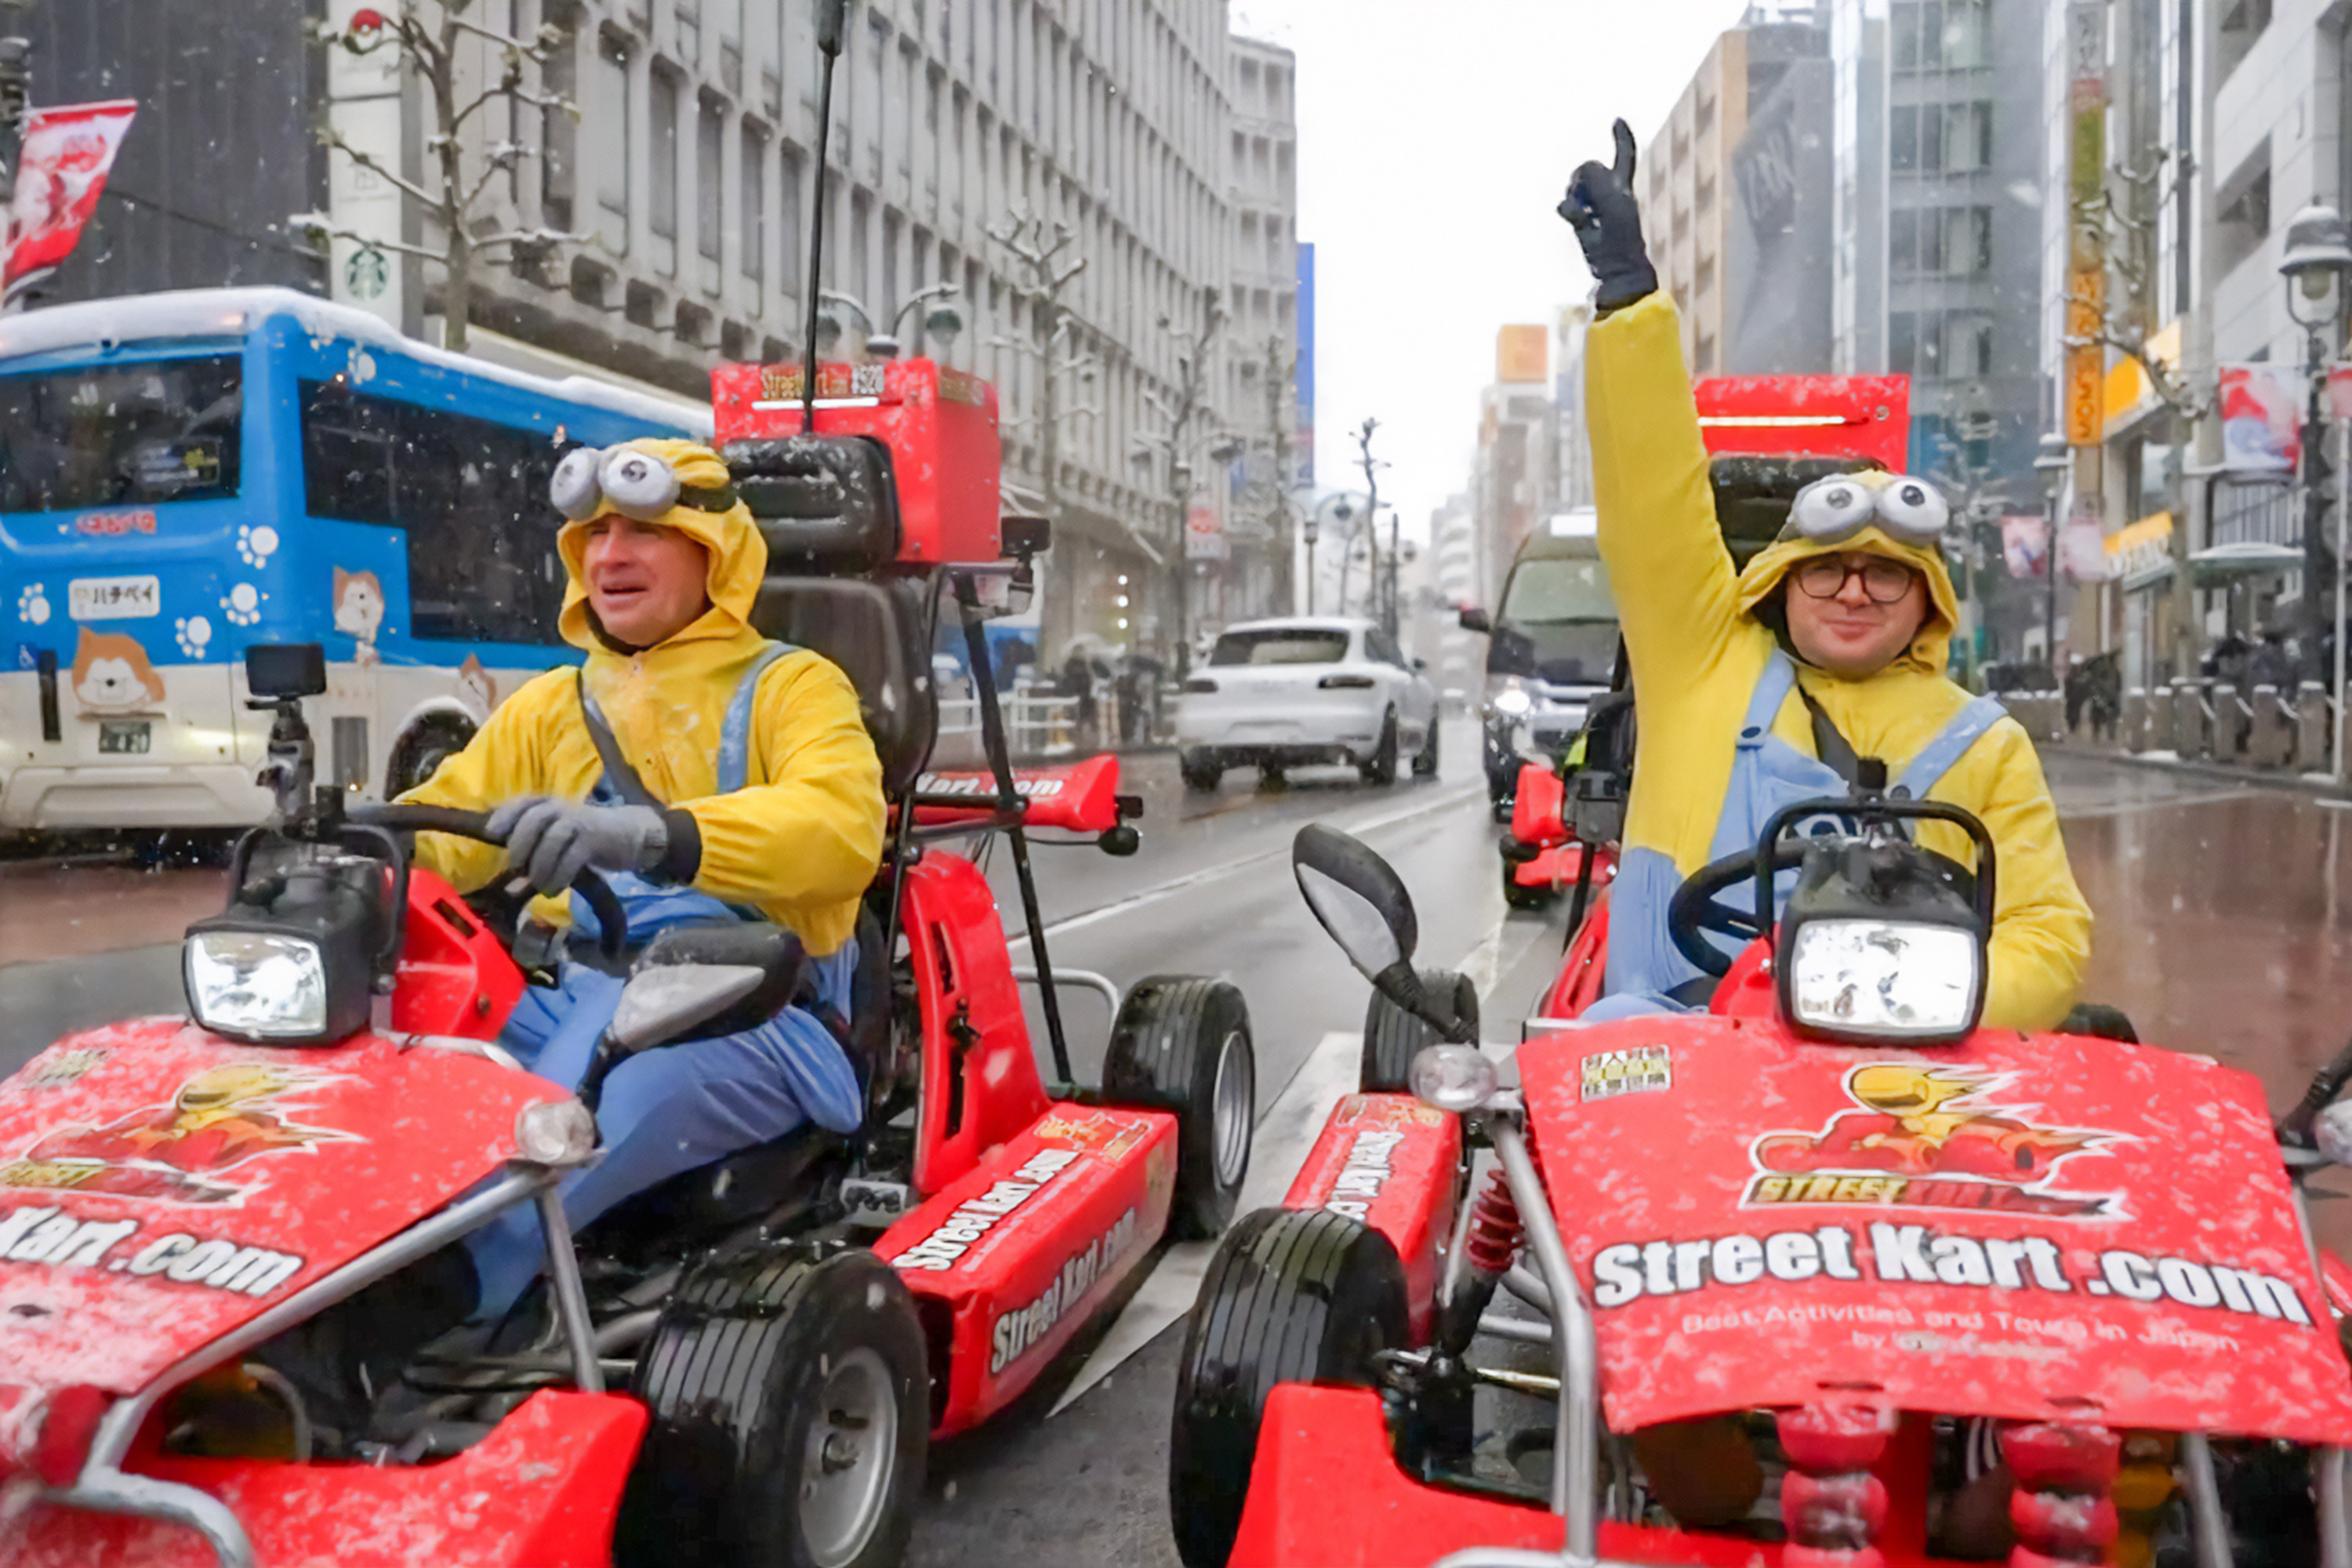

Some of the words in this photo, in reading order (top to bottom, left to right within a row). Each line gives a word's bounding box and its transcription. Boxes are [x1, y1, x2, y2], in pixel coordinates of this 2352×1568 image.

[1755, 1175, 1908, 1203] STREET
[1593, 1228, 1860, 1308] Street
[1870, 1221, 2071, 1292] Kart
[2088, 1250, 2317, 1325] .com
[1924, 1310, 1984, 1330] and
